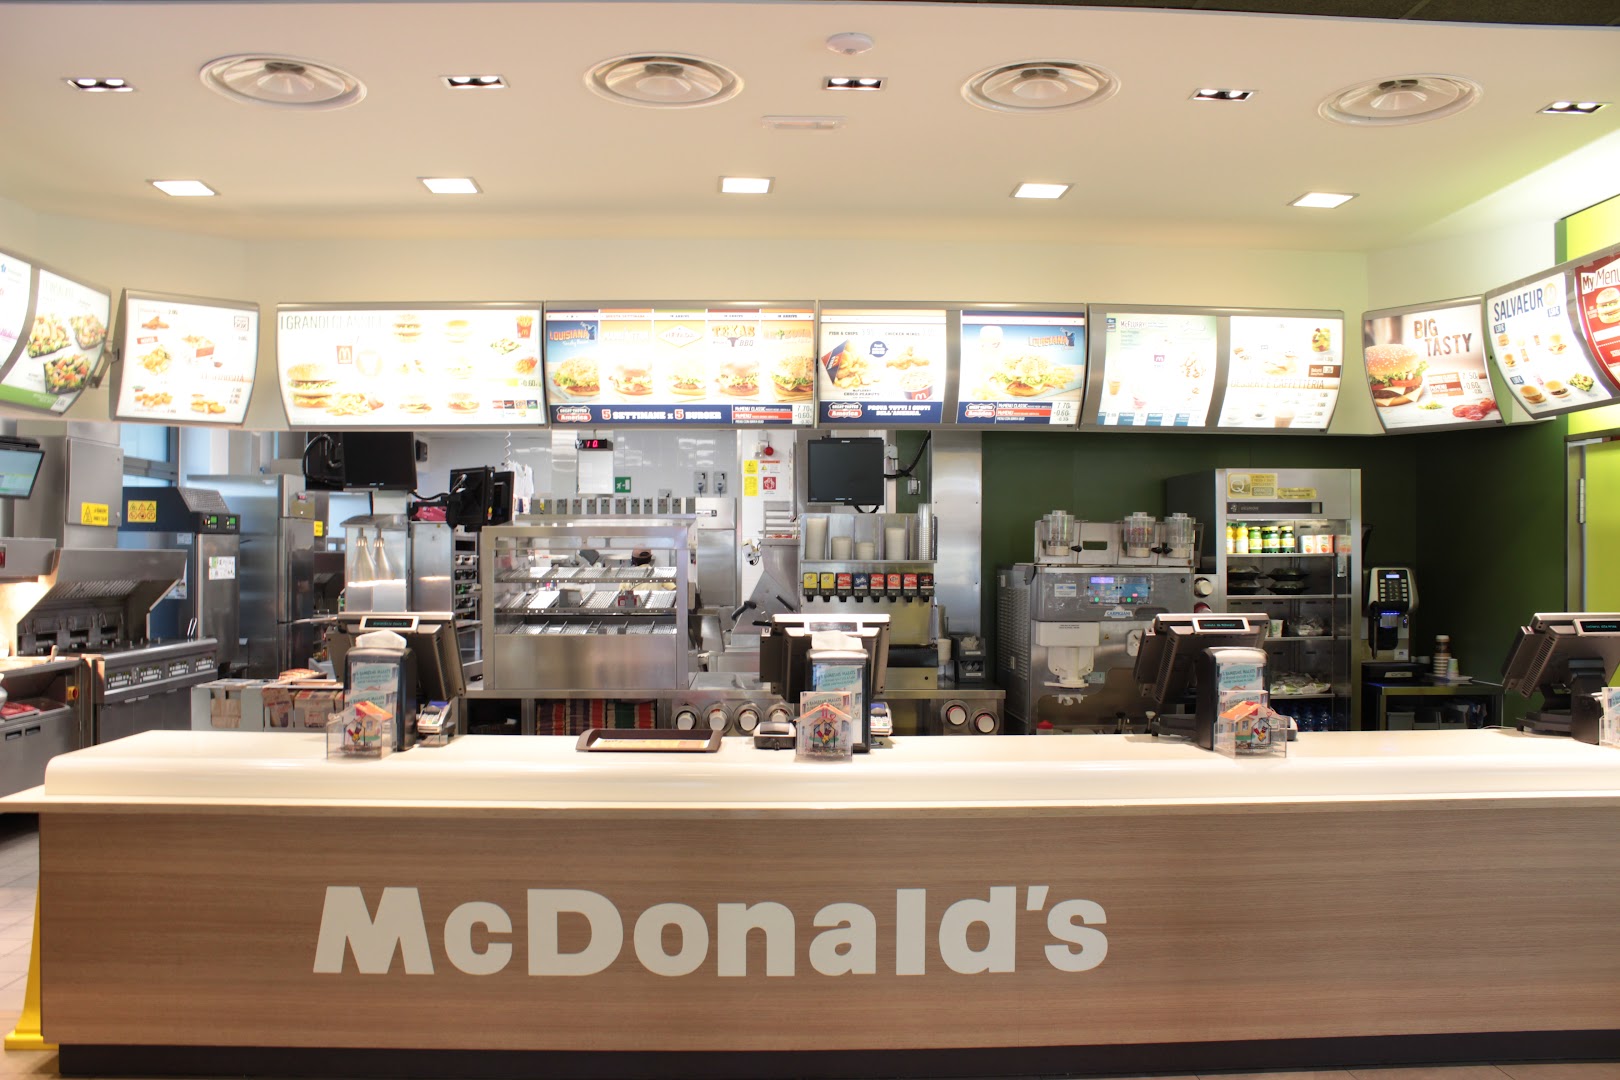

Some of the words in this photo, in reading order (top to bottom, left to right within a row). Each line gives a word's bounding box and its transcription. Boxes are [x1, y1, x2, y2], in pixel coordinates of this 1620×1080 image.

[1582, 275, 1594, 291] My
[286, 315, 328, 329] GRANDI
[1414, 319, 1438, 339] BIG
[550, 329, 588, 341] LOUISIANA
[712, 325, 755, 337] TEXAS
[1028, 336, 1067, 347] LOUISIANA
[1425, 333, 1473, 357] TASTY
[602, 409, 611, 420] 5
[613, 411, 667, 420] SETTIMANE
[675, 408, 684, 420] 5
[685, 411, 722, 420] BURGER
[312, 885, 1109, 977] McDonald's
